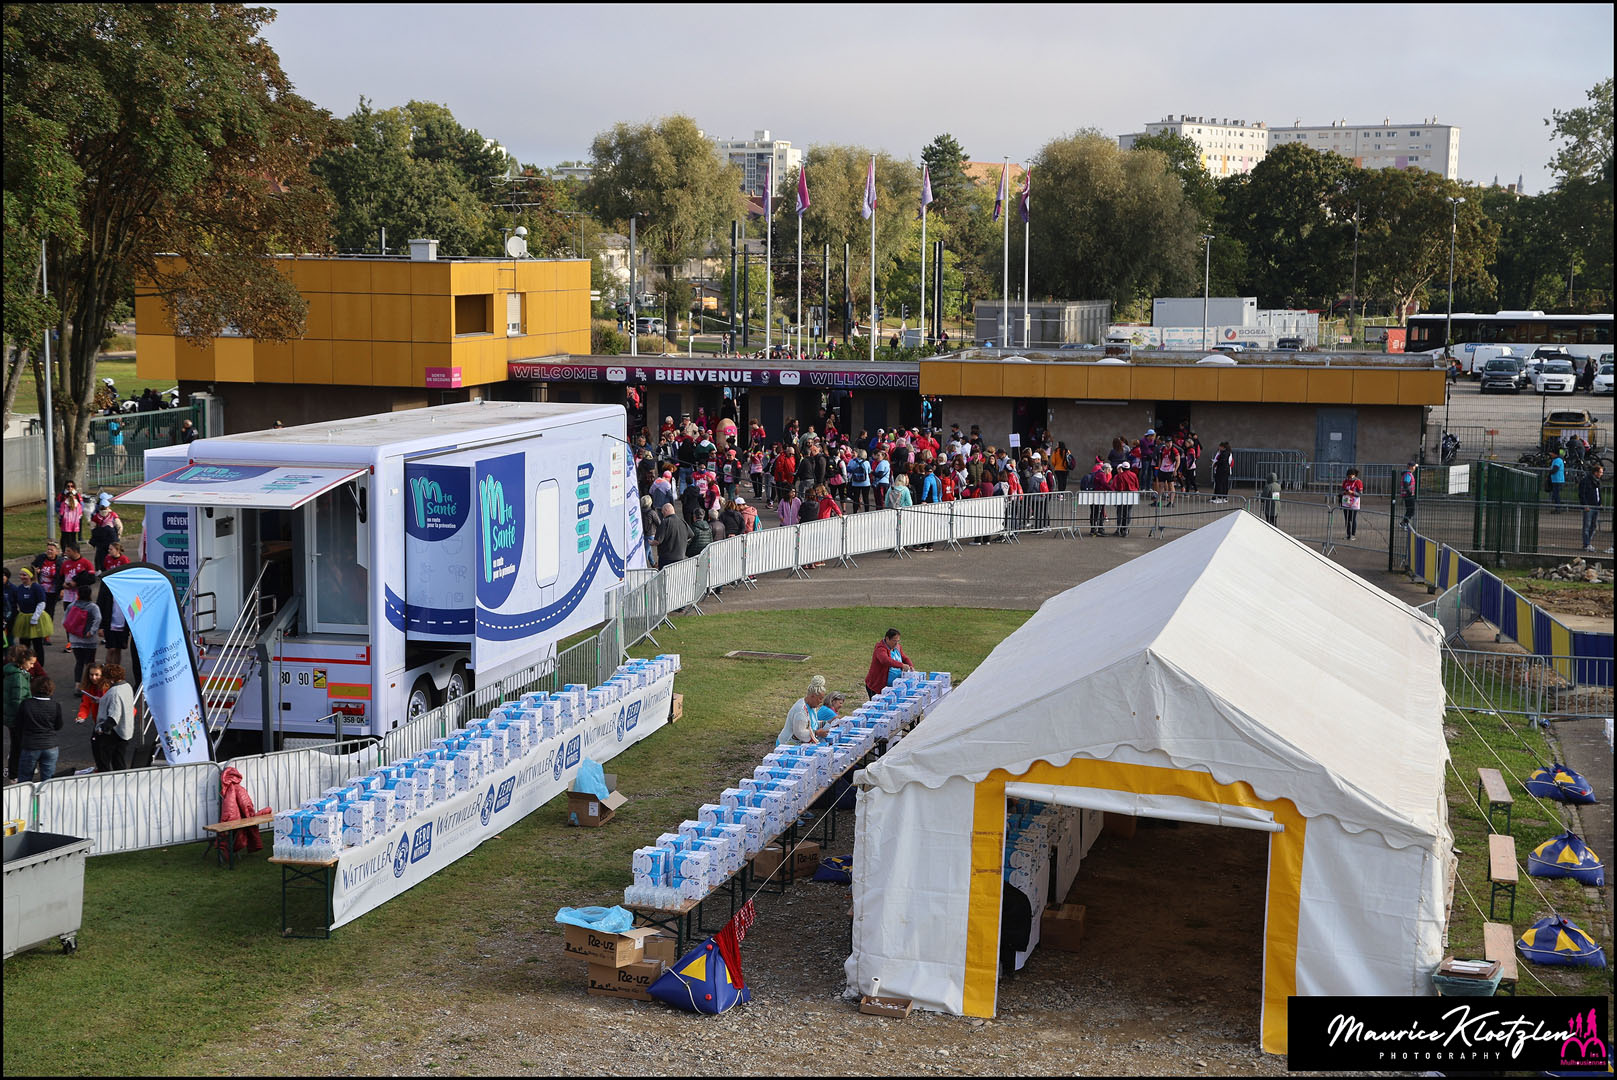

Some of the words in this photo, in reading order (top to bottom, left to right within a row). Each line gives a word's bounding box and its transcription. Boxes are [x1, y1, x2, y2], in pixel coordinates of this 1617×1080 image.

[513, 366, 598, 380] WELCOME
[655, 369, 752, 382] BIENVENUE
[426, 501, 457, 516] Santé
[492, 520, 516, 552] Santé
[298, 672, 309, 685] 90
